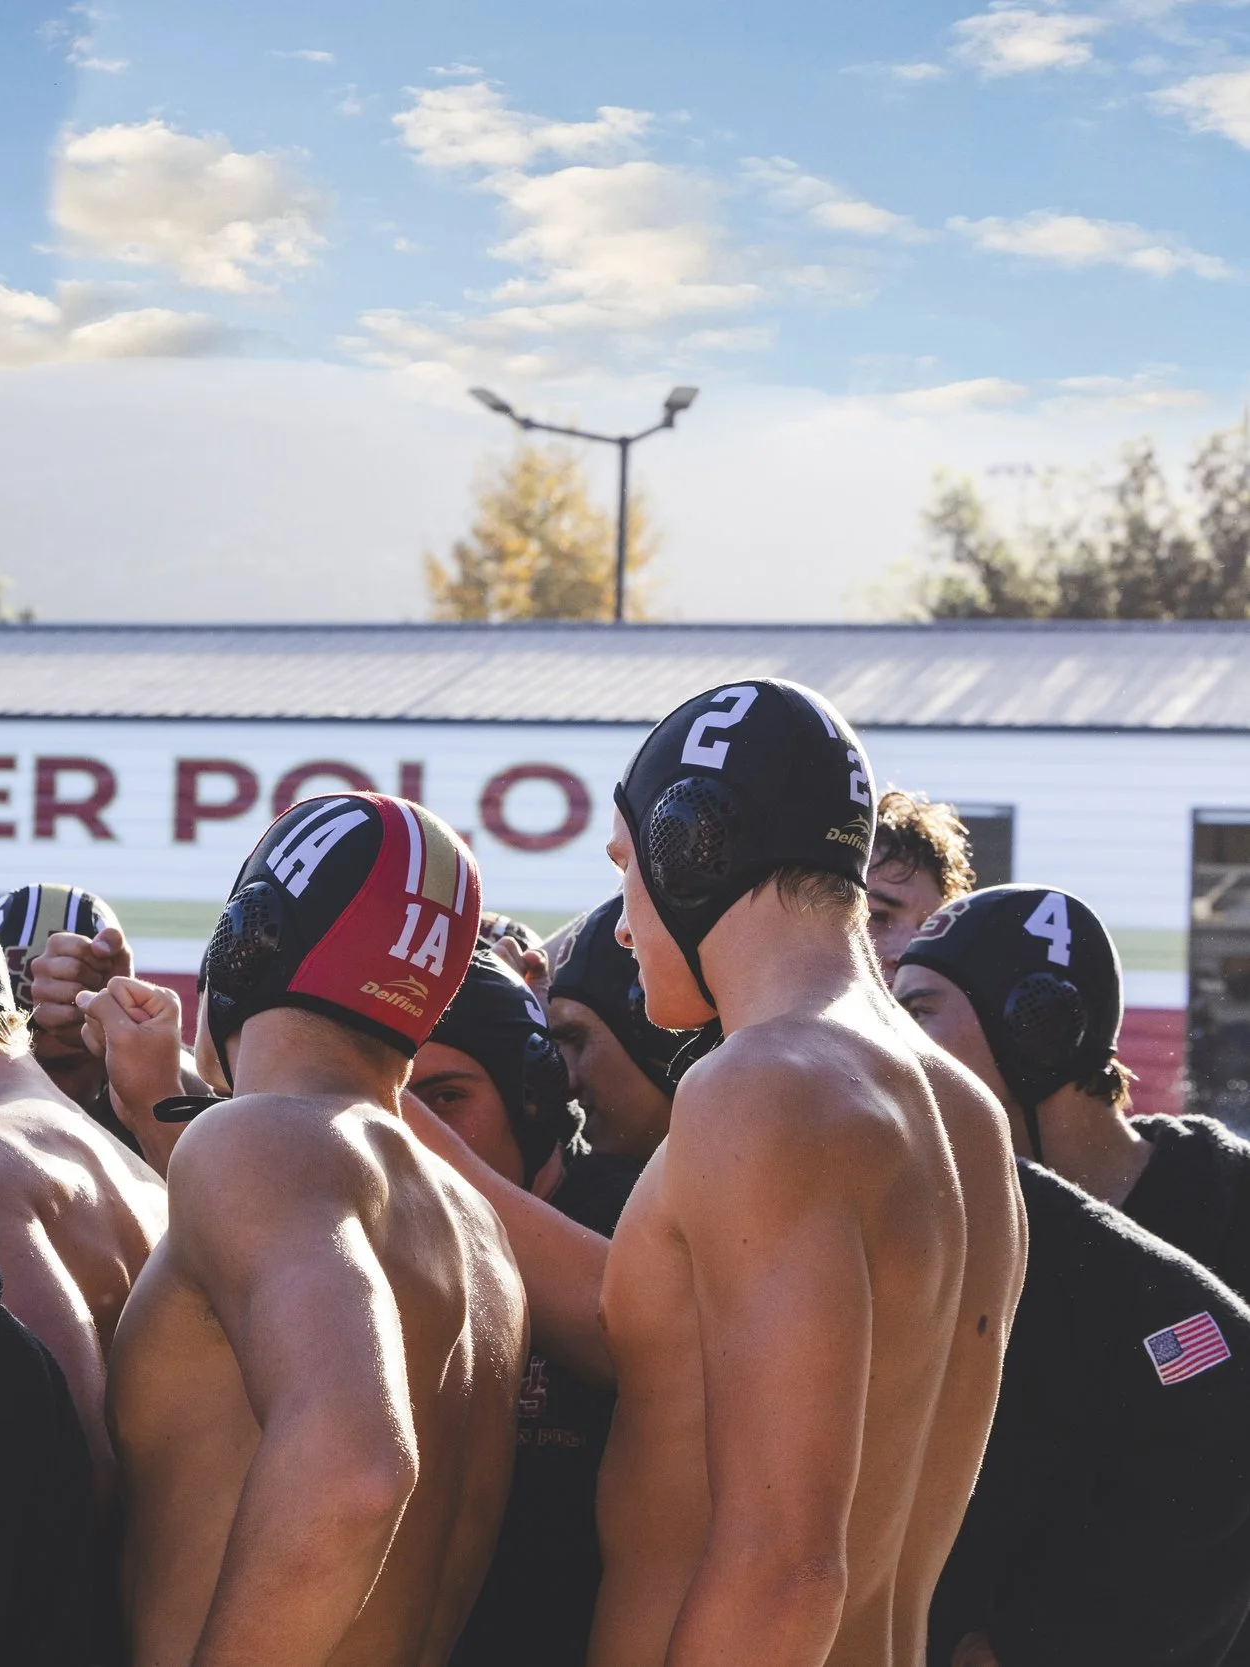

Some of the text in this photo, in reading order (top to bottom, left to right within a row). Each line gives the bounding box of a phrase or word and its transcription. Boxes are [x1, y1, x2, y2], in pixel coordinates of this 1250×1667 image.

[680, 685, 759, 770] 2
[846, 748, 870, 808] 2
[265, 797, 371, 900] 1A
[388, 902, 450, 979] 1A
[1022, 891, 1072, 967] 4
[358, 980, 424, 1018] Delfina
